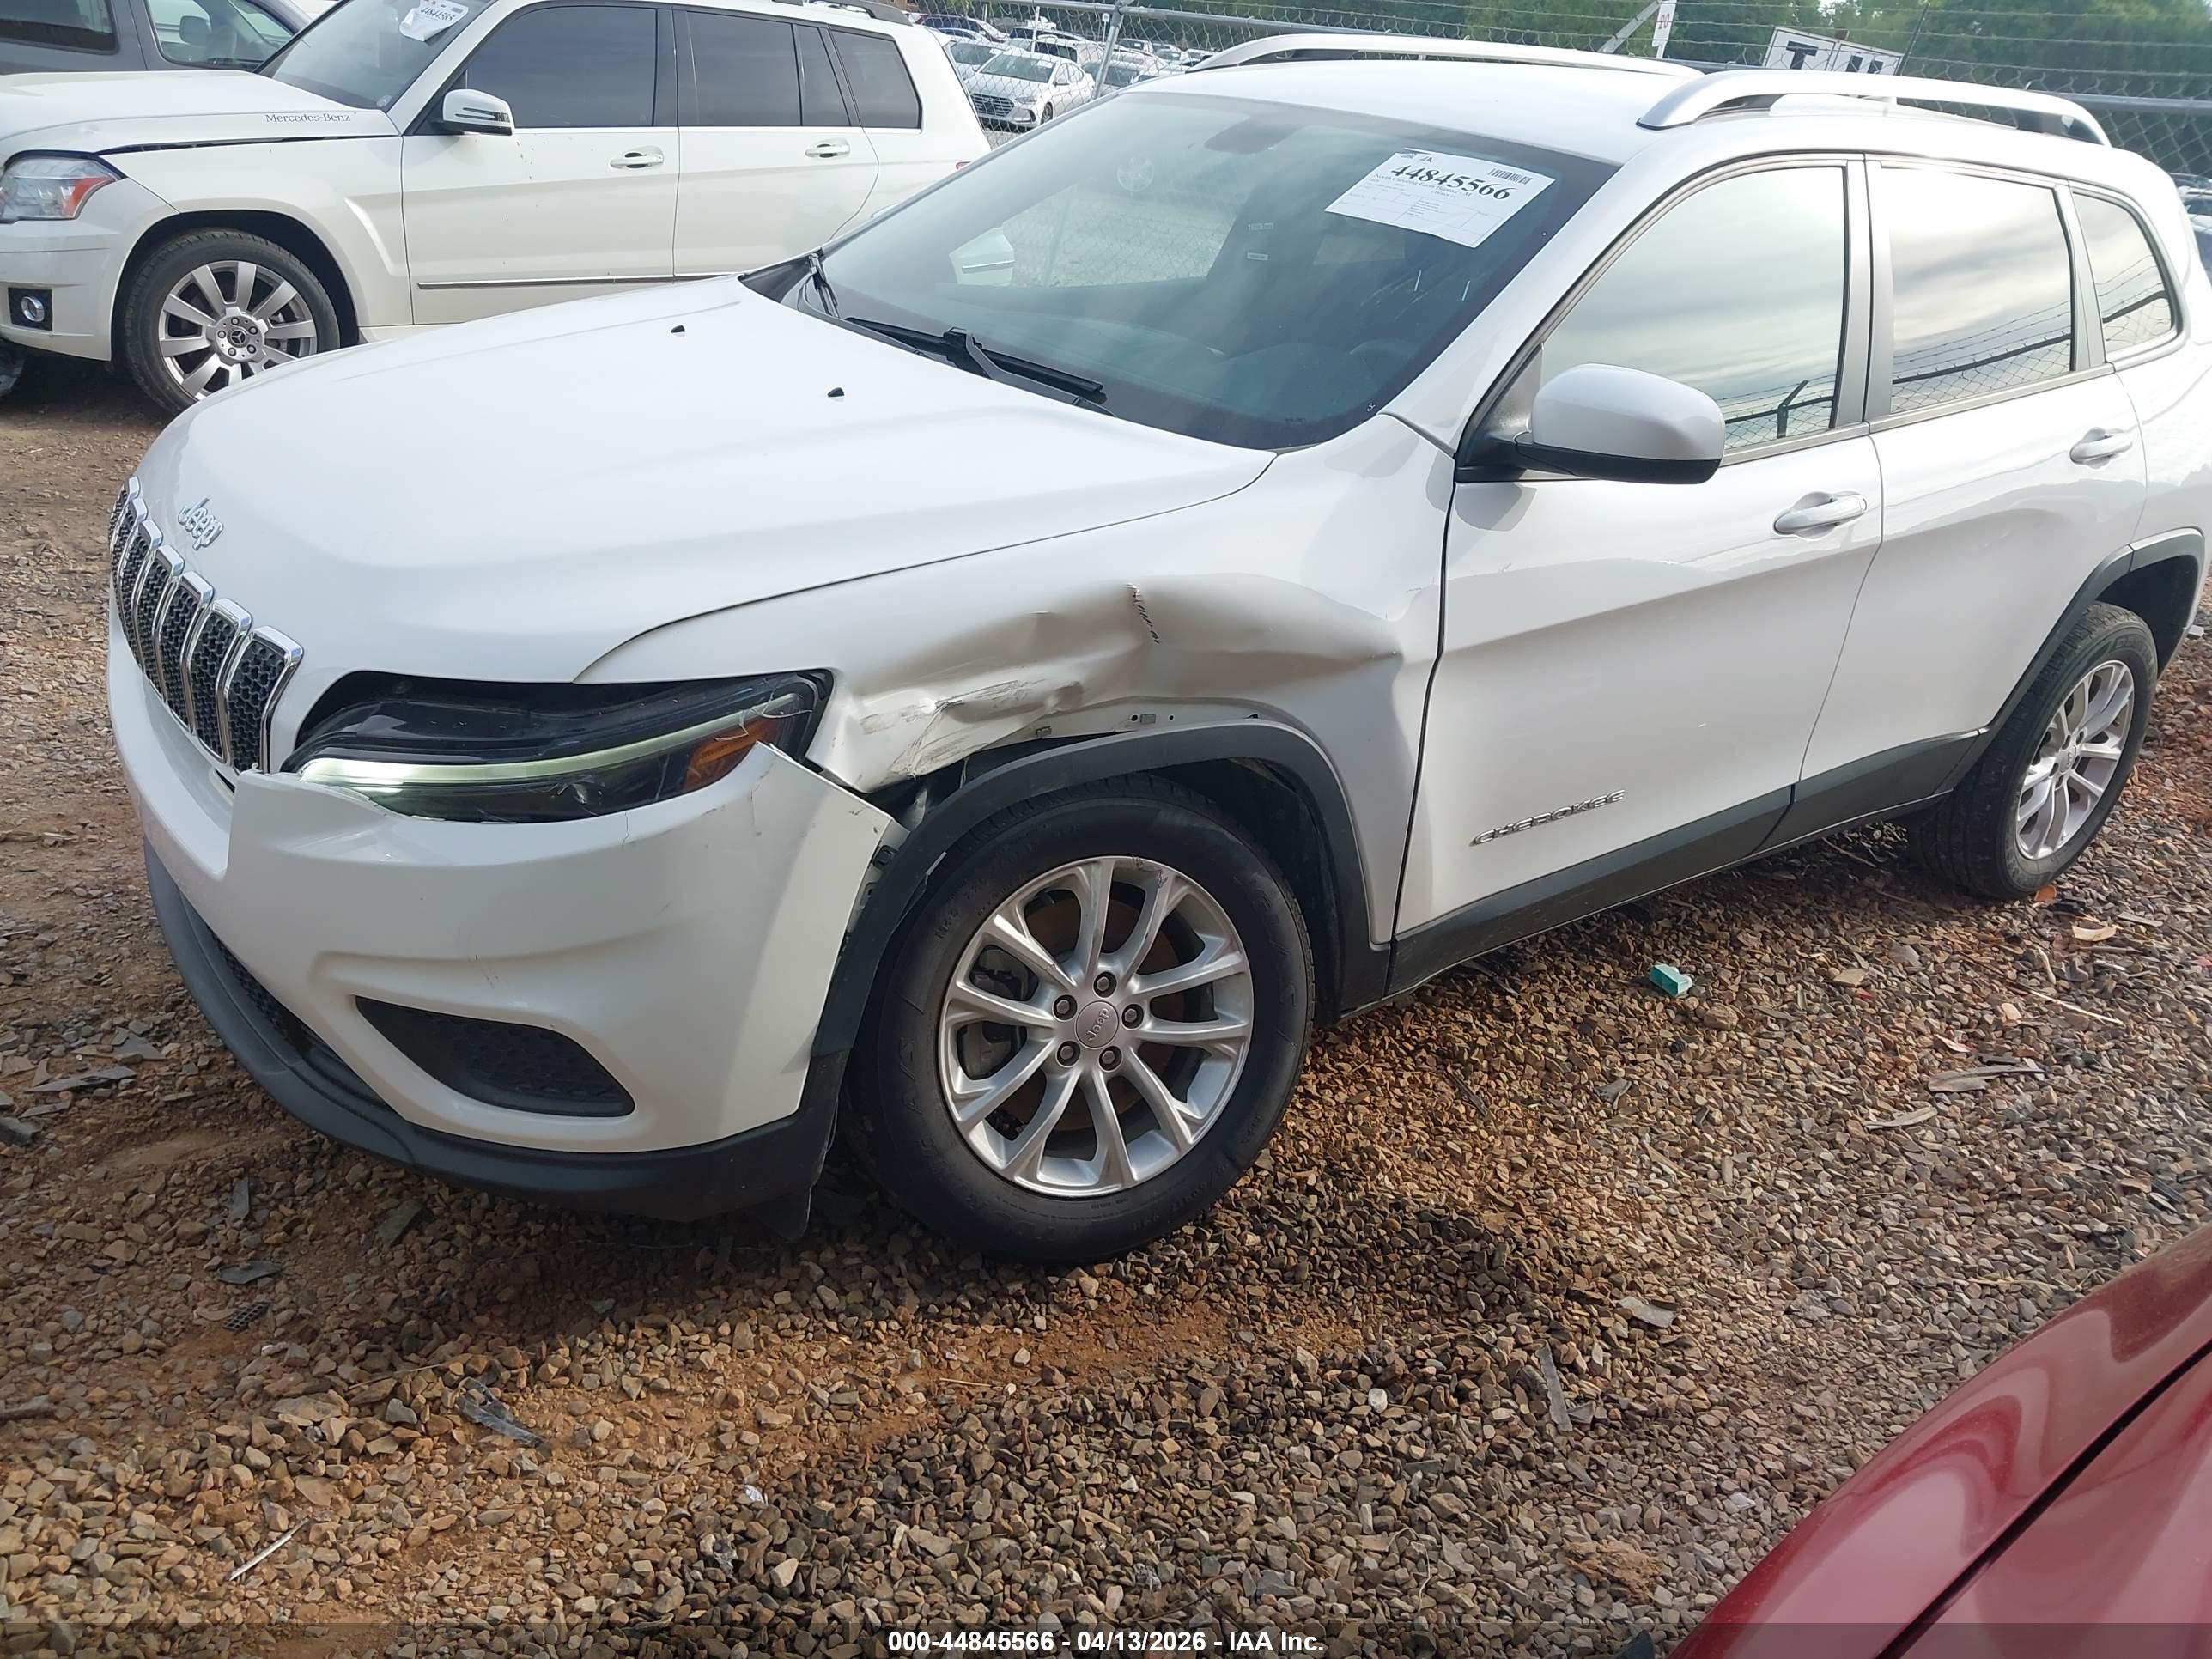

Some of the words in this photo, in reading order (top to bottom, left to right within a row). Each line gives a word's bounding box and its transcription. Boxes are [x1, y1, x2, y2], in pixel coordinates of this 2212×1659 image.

[265, 113, 351, 123] Mercedes-Benz
[1391, 164, 1518, 200] 44845566
[178, 497, 224, 551] Jeep
[1469, 789, 1626, 847] CHEROKEE
[1085, 1008, 1109, 1042] Jeep
